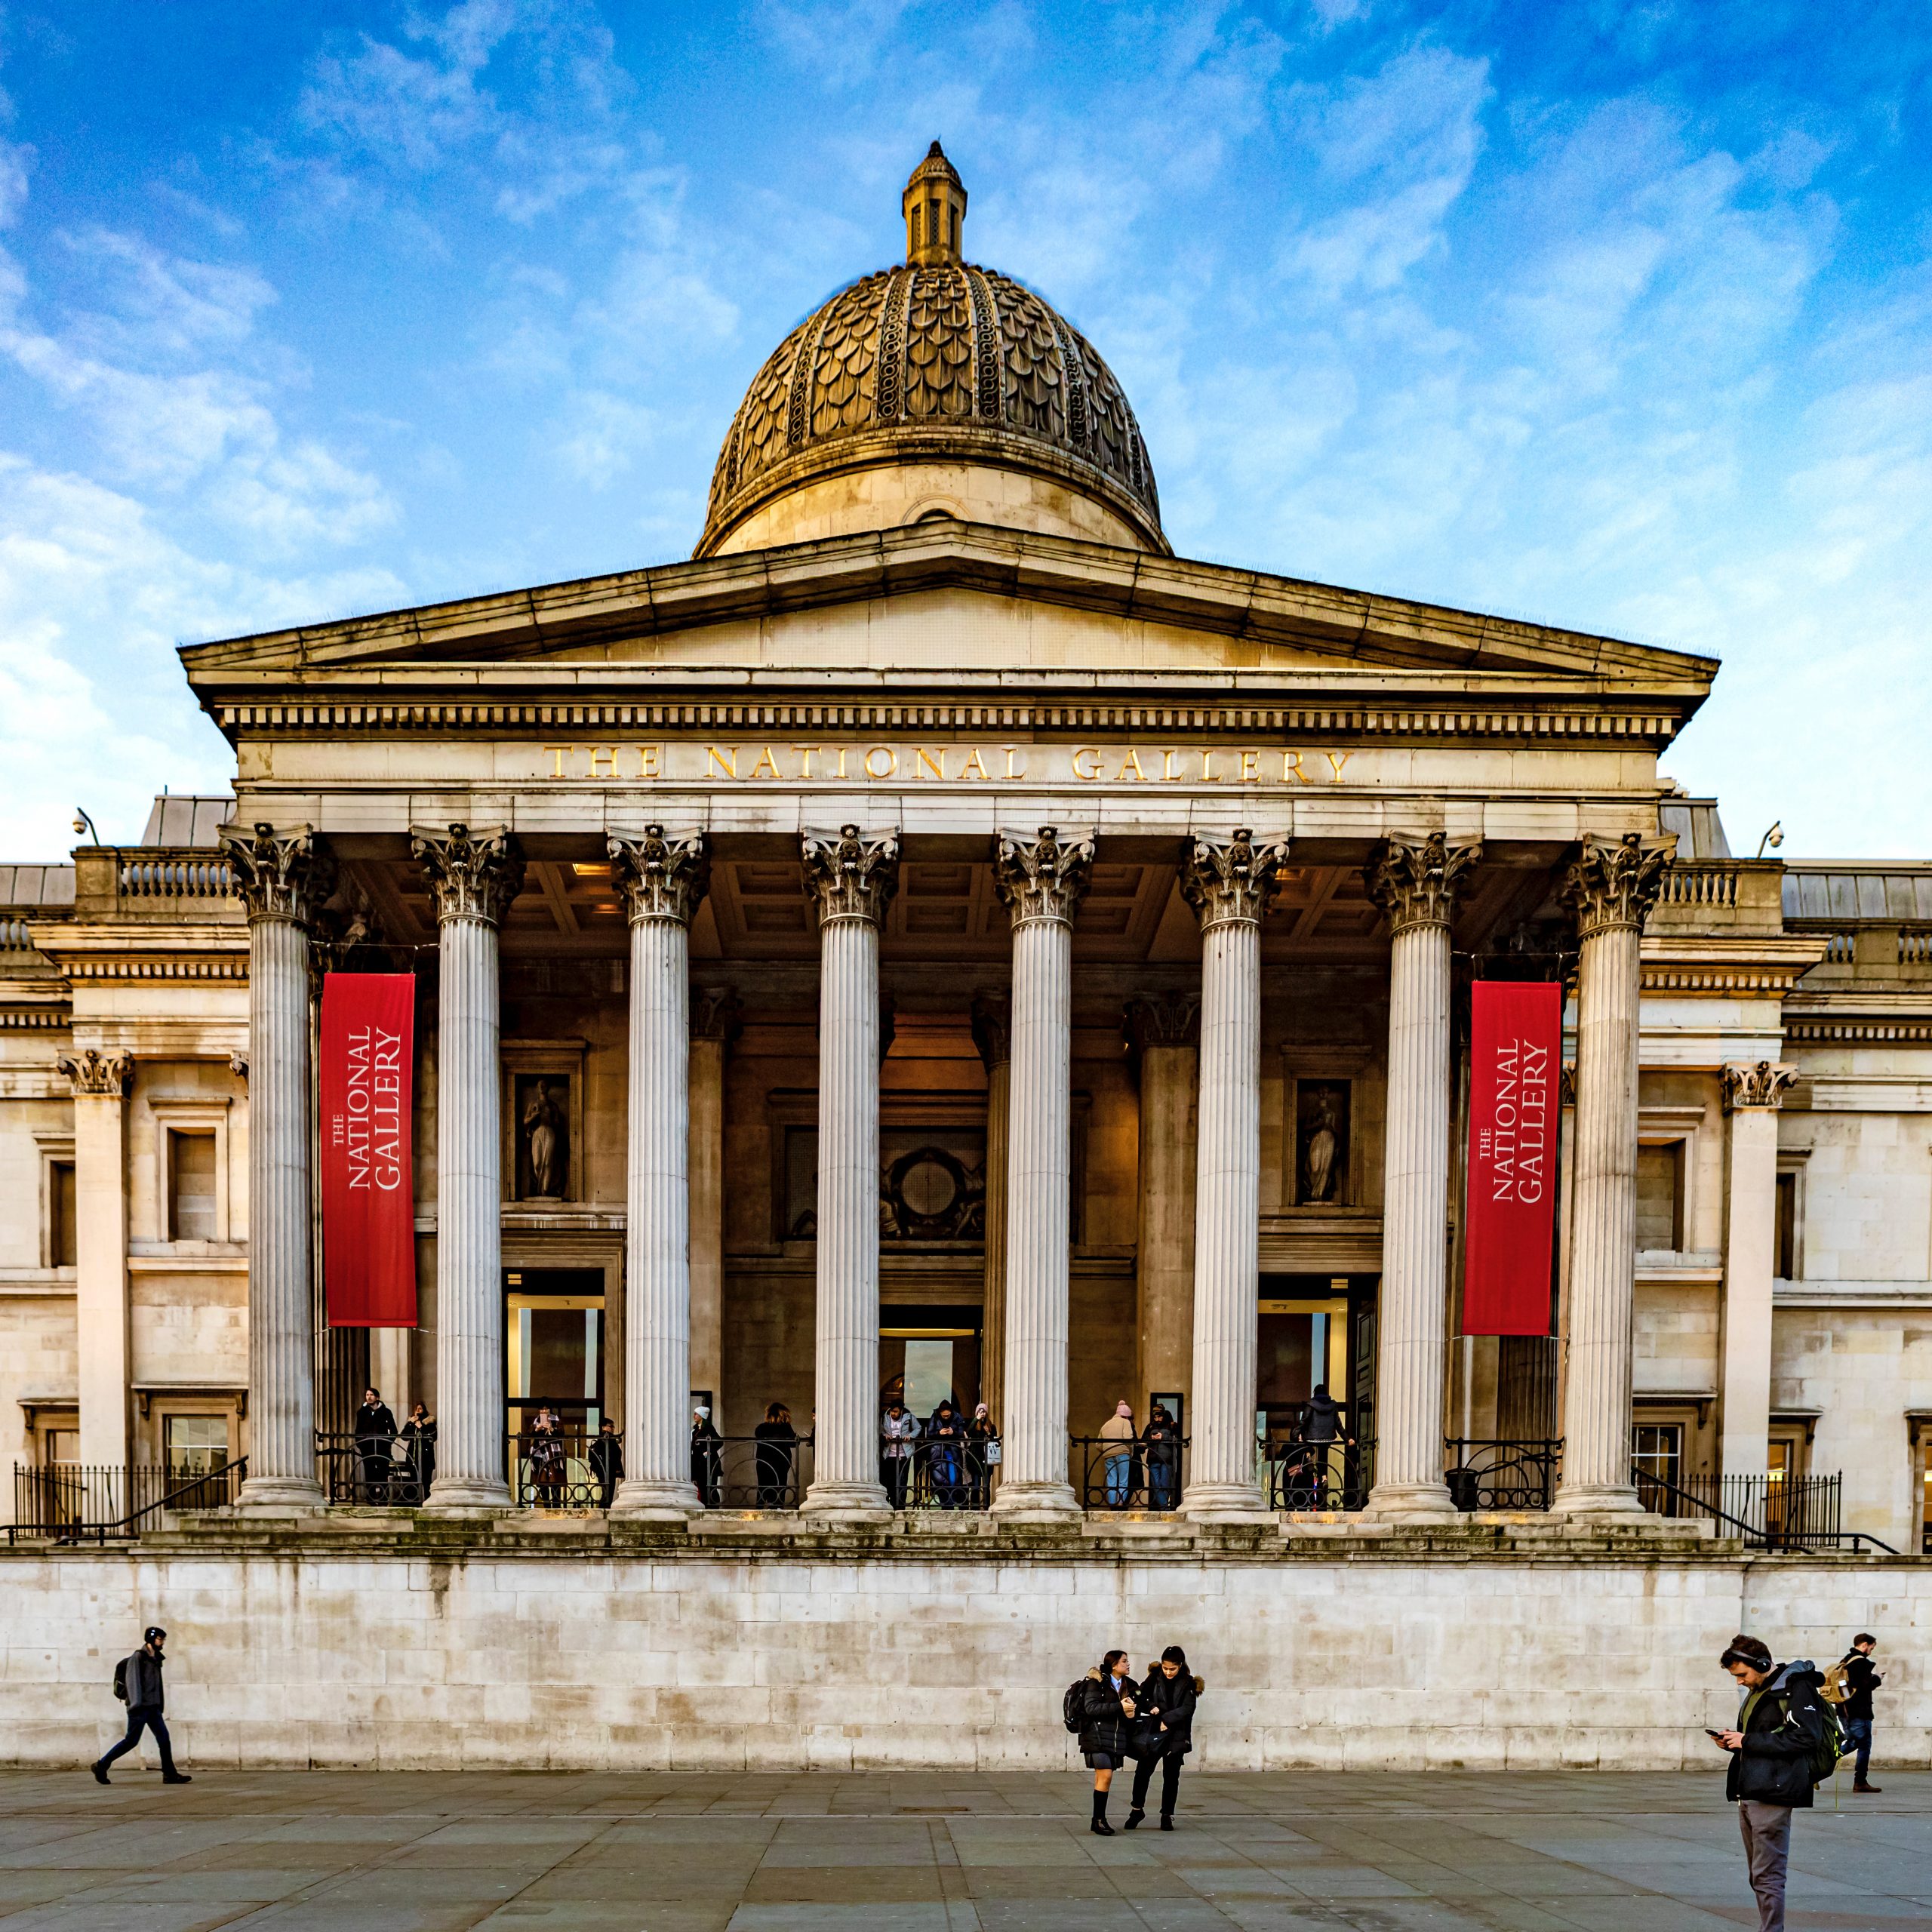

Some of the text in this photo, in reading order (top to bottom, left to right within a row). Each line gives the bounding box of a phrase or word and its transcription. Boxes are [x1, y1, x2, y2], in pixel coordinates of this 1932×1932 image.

[543, 746, 1355, 783] THE NATIONAL GALLERY
[333, 1114, 344, 1146] THE
[347, 1026, 371, 1190] NATIONAL
[375, 1026, 401, 1190] GALLERY
[1479, 1128, 1491, 1160] THE
[1494, 1038, 1518, 1202] NATIONAL
[1518, 1038, 1548, 1204] GALLERY
